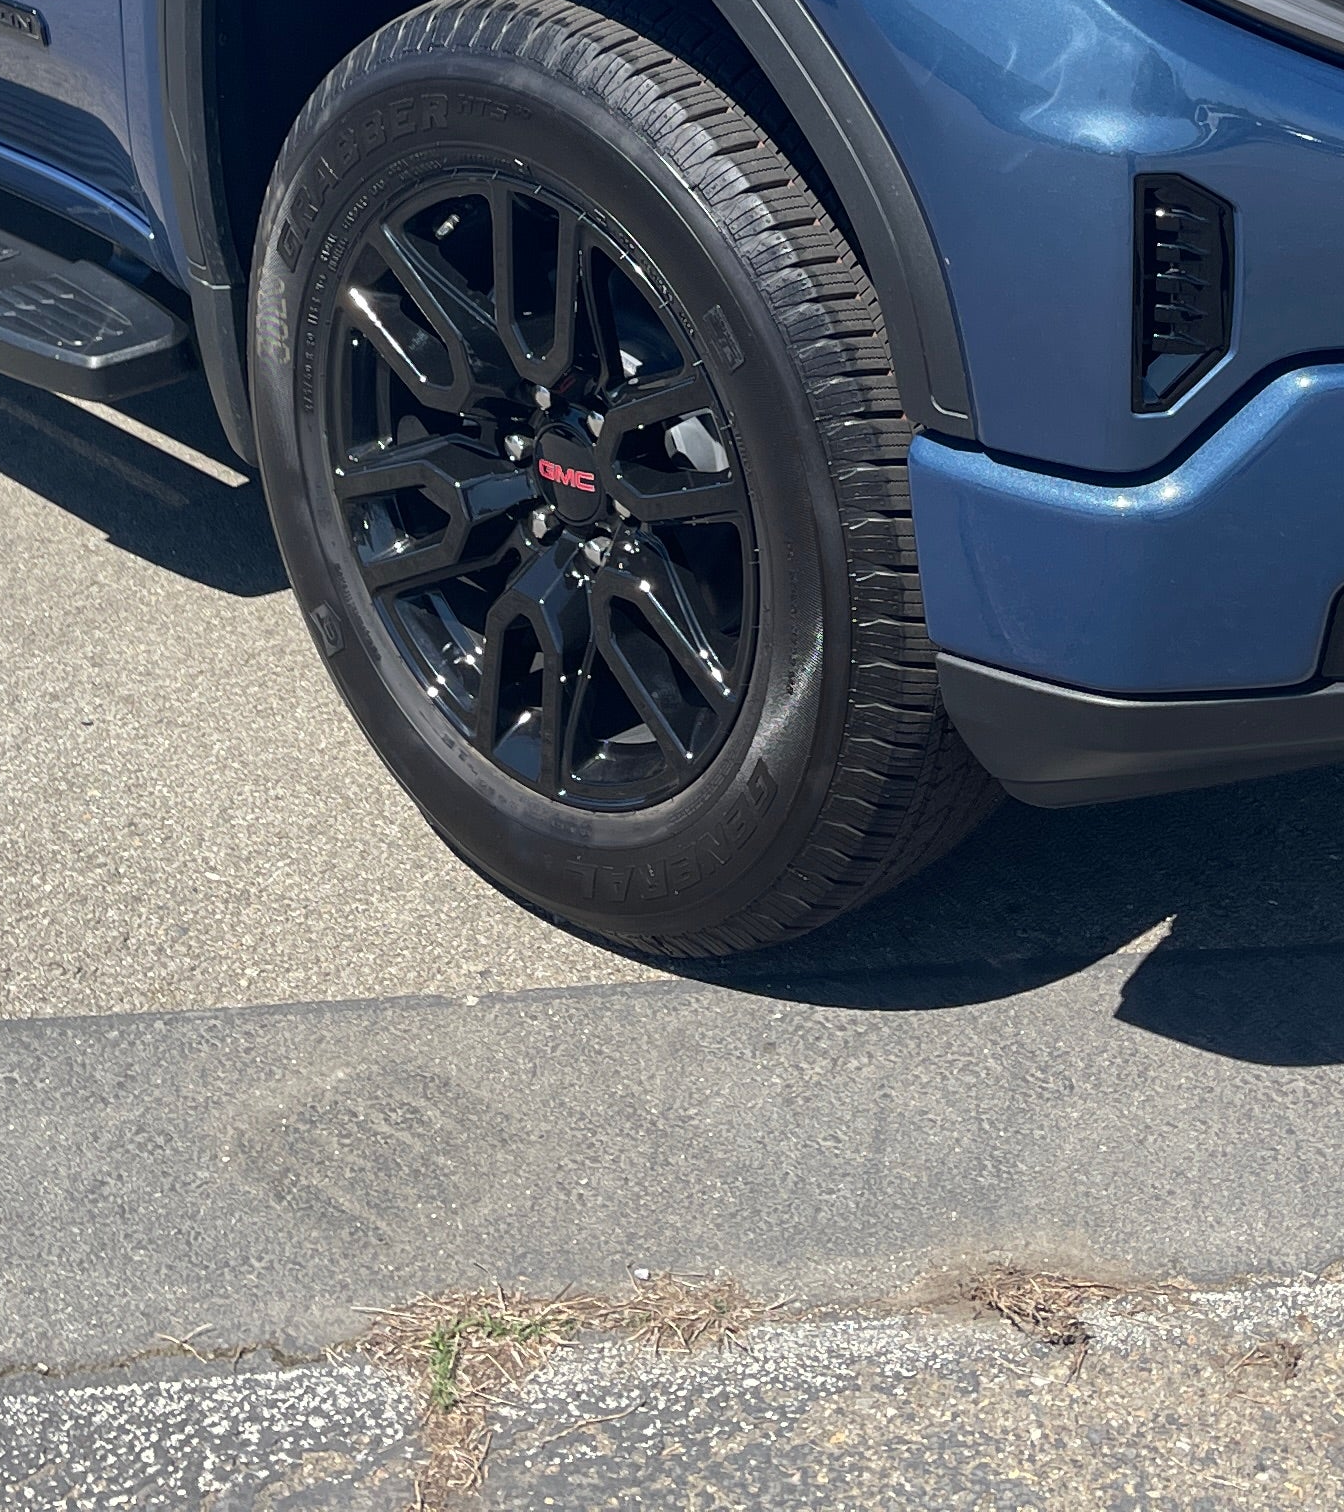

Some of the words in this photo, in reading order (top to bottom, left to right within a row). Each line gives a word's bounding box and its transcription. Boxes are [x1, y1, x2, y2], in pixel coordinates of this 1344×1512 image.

[277, 94, 449, 273] GRABBER
[538, 458, 595, 492] GMC
[564, 757, 779, 903] GENERAL
